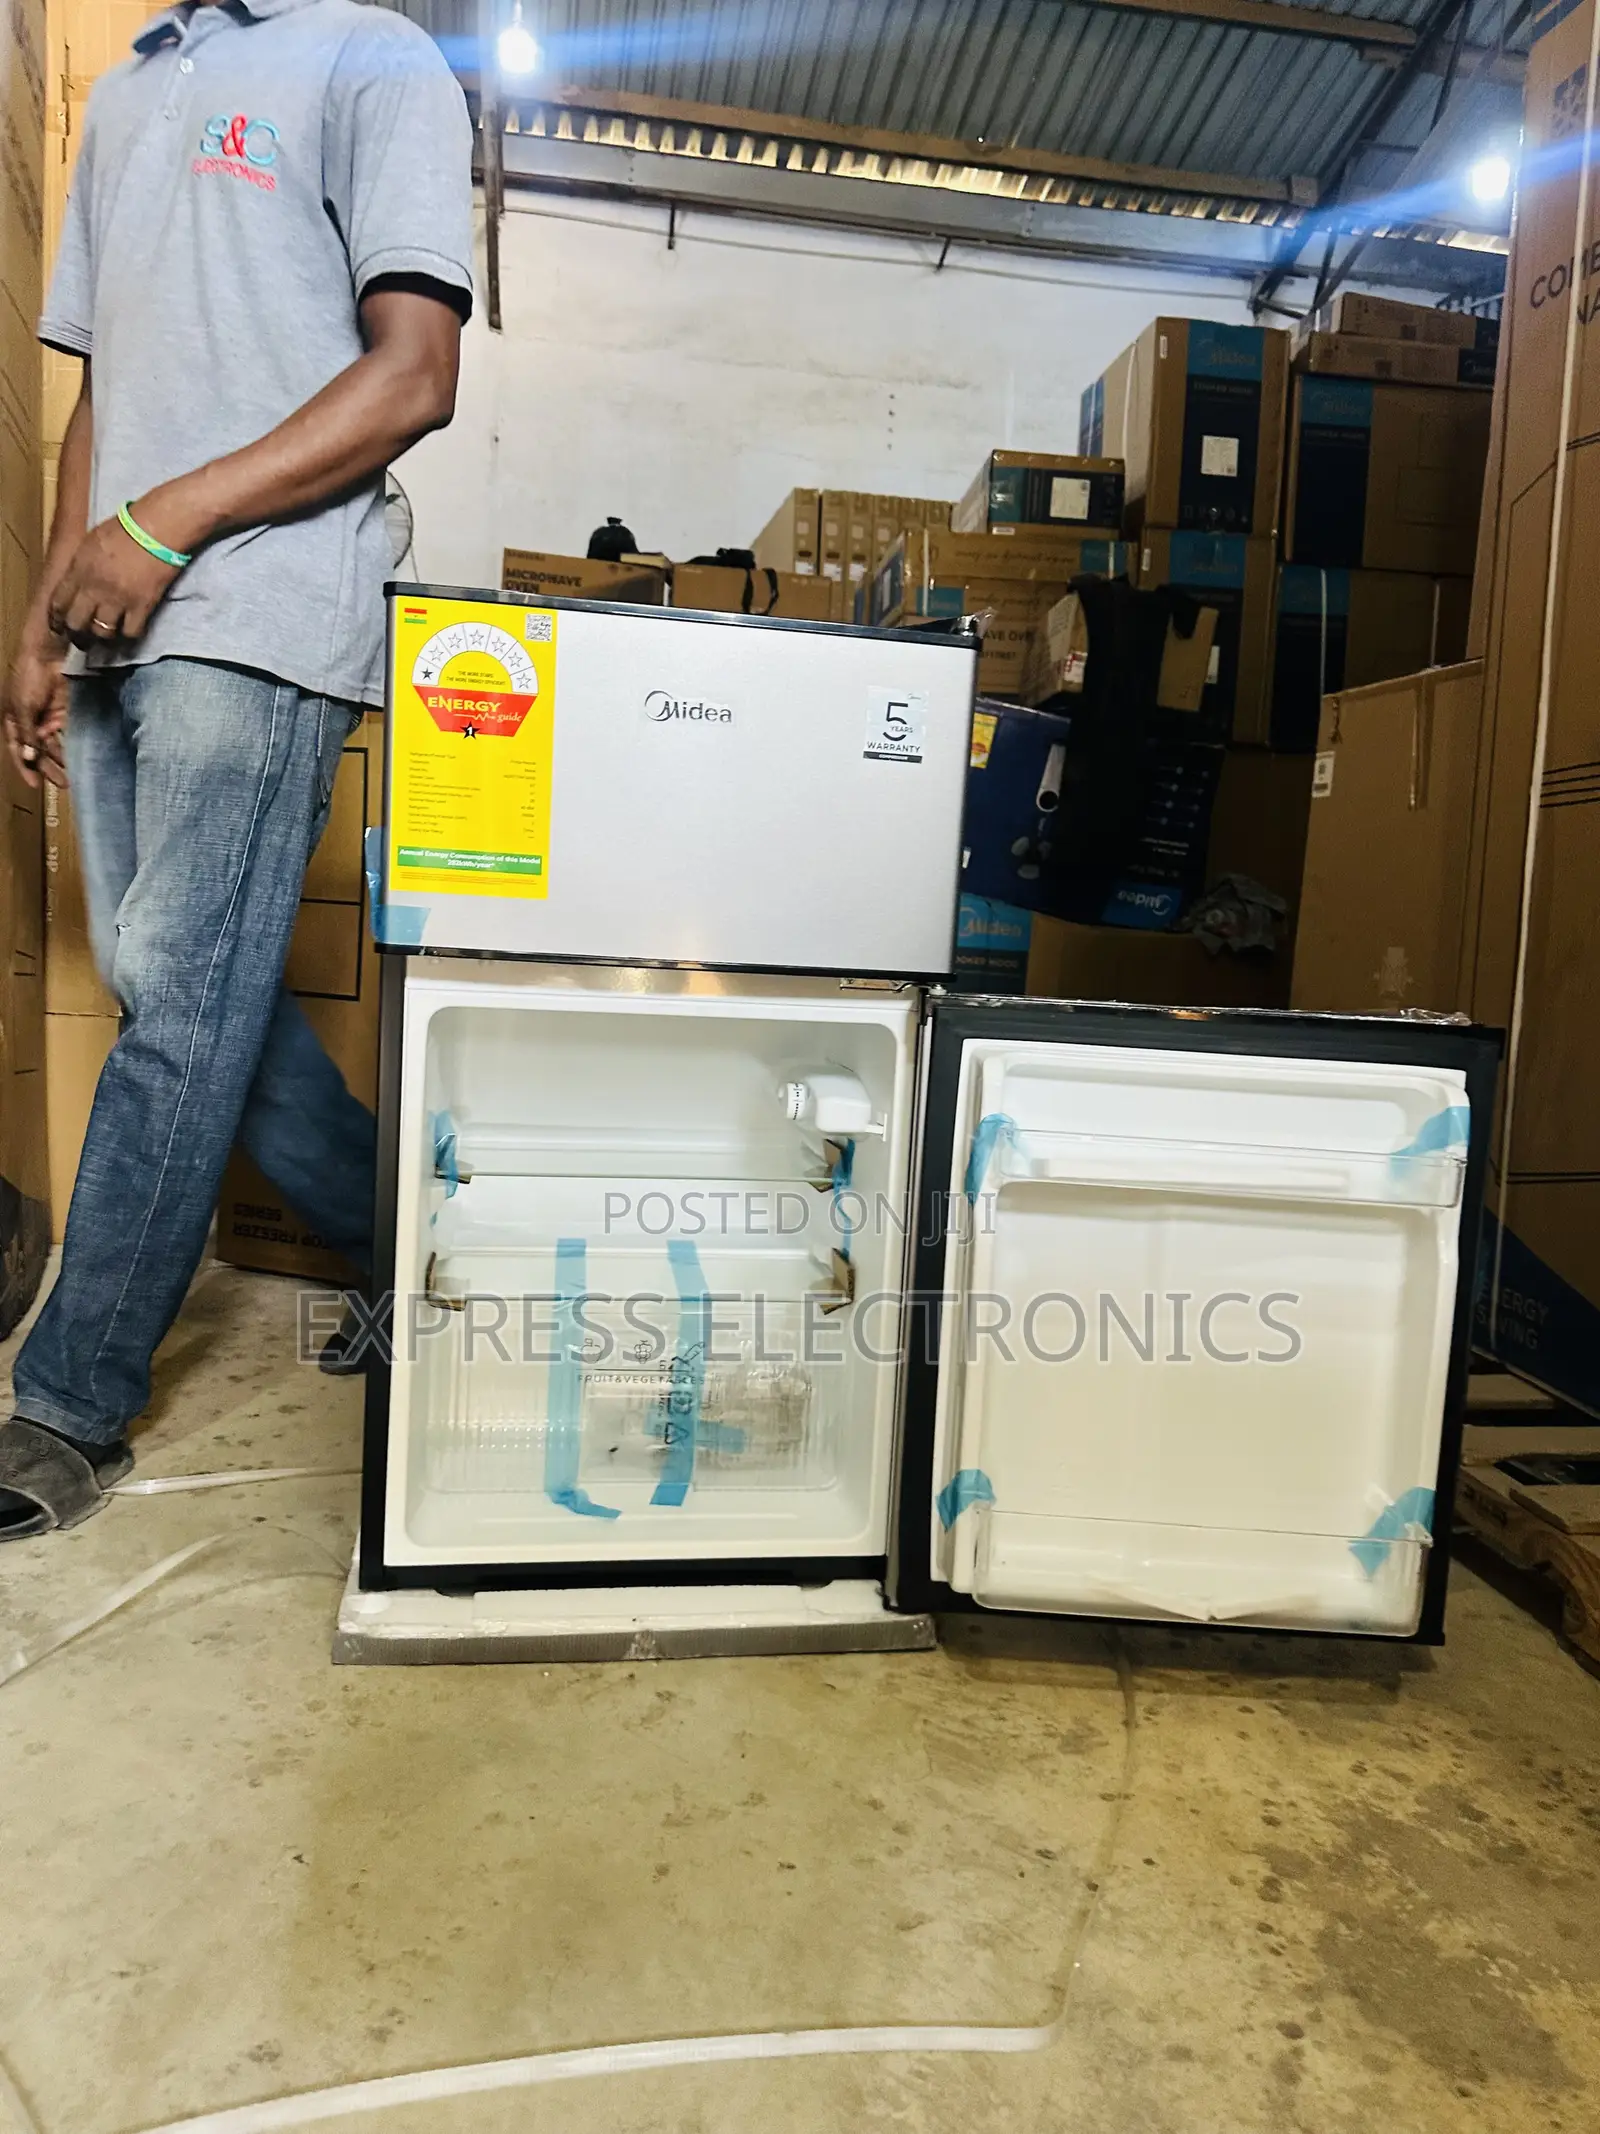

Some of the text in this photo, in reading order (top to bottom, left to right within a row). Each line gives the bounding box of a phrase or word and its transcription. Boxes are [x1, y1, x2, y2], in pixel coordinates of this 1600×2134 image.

[505, 567, 583, 588] MICROWAVE
[427, 695, 502, 713] ENERGY
[644, 689, 732, 723] Midea
[497, 711, 523, 723] guide
[882, 701, 909, 742] 5
[890, 725, 914, 734] YEARS
[866, 740, 921, 754] WARRANTY
